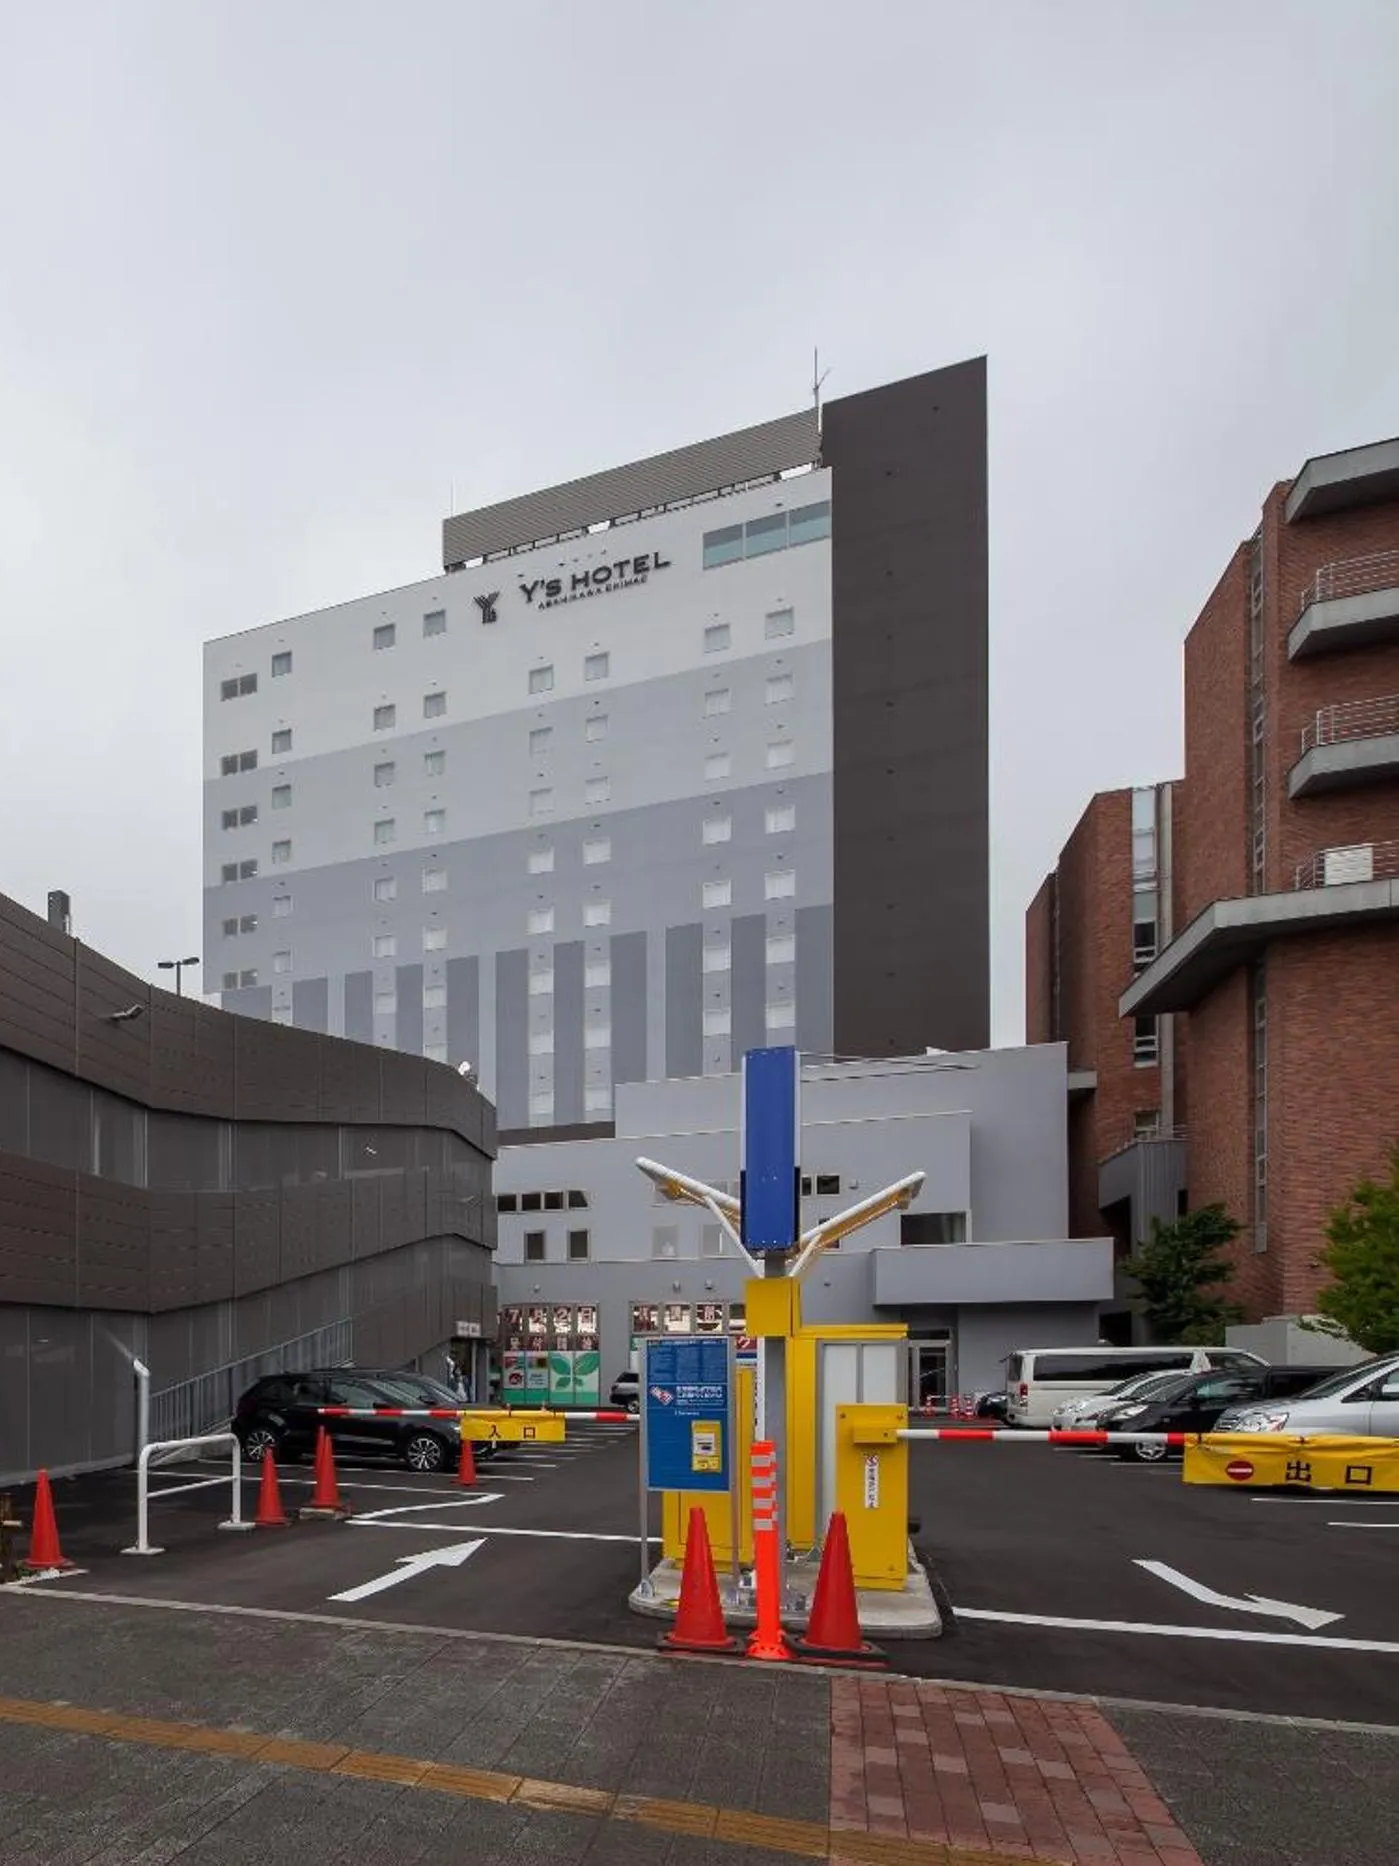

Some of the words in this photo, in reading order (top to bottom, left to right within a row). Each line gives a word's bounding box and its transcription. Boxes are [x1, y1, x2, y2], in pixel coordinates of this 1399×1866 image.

[519, 578, 563, 603] Y'S
[570, 551, 671, 590] HOTEL
[488, 1424, 536, 1439] 入口
[1285, 1459, 1373, 1486] 出口
